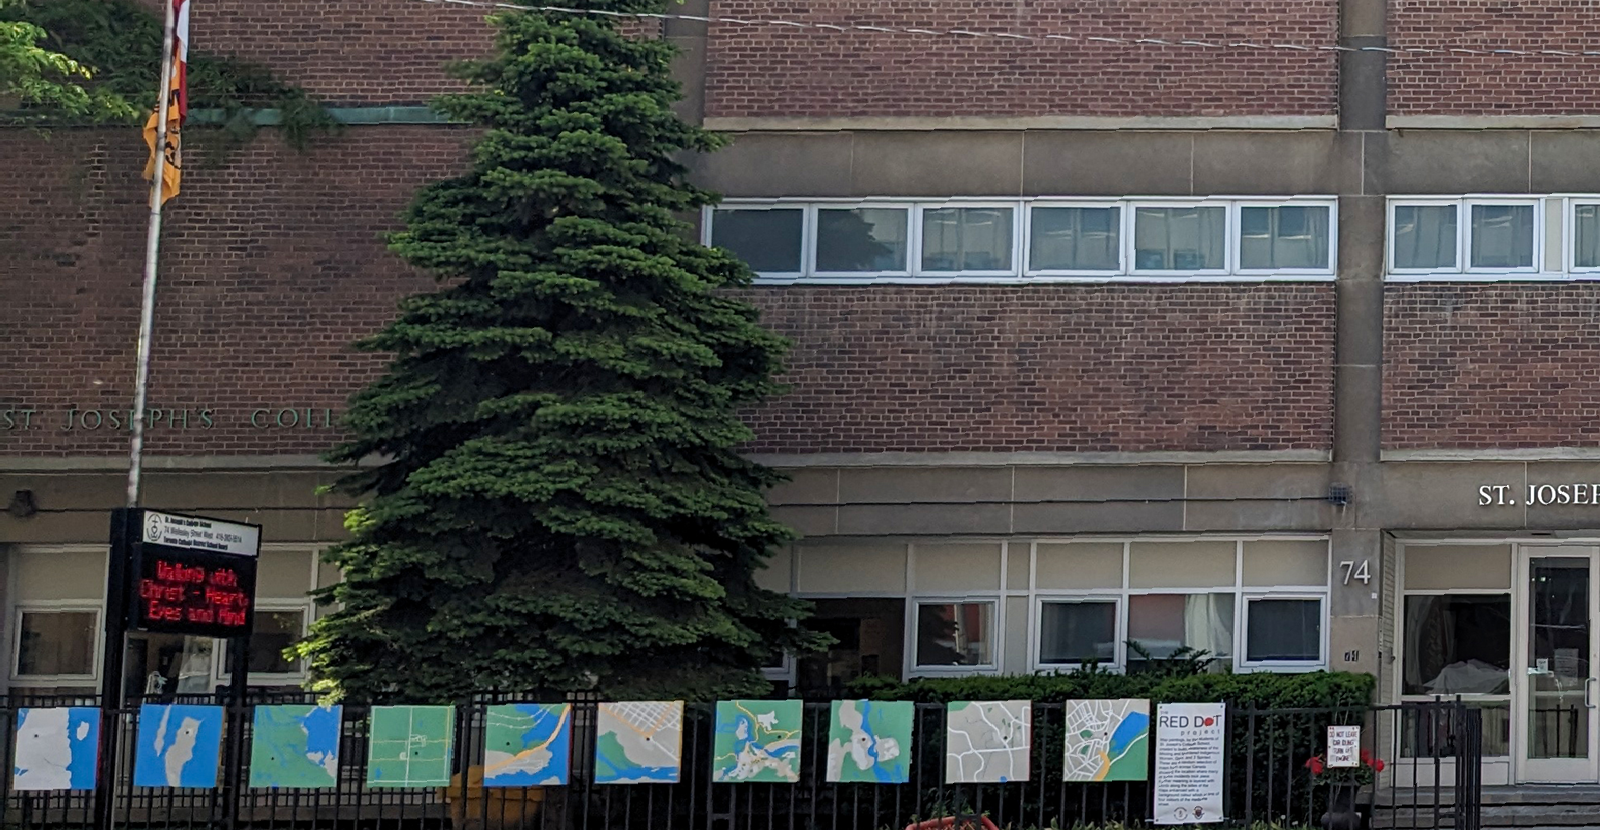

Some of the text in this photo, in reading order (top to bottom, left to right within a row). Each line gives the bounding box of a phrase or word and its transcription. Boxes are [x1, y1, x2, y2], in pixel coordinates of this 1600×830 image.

[1478, 485, 1515, 505] ST.
[1340, 560, 1371, 585] 74
[1159, 714, 1222, 728] RED DOT
[1180, 729, 1221, 737] project
